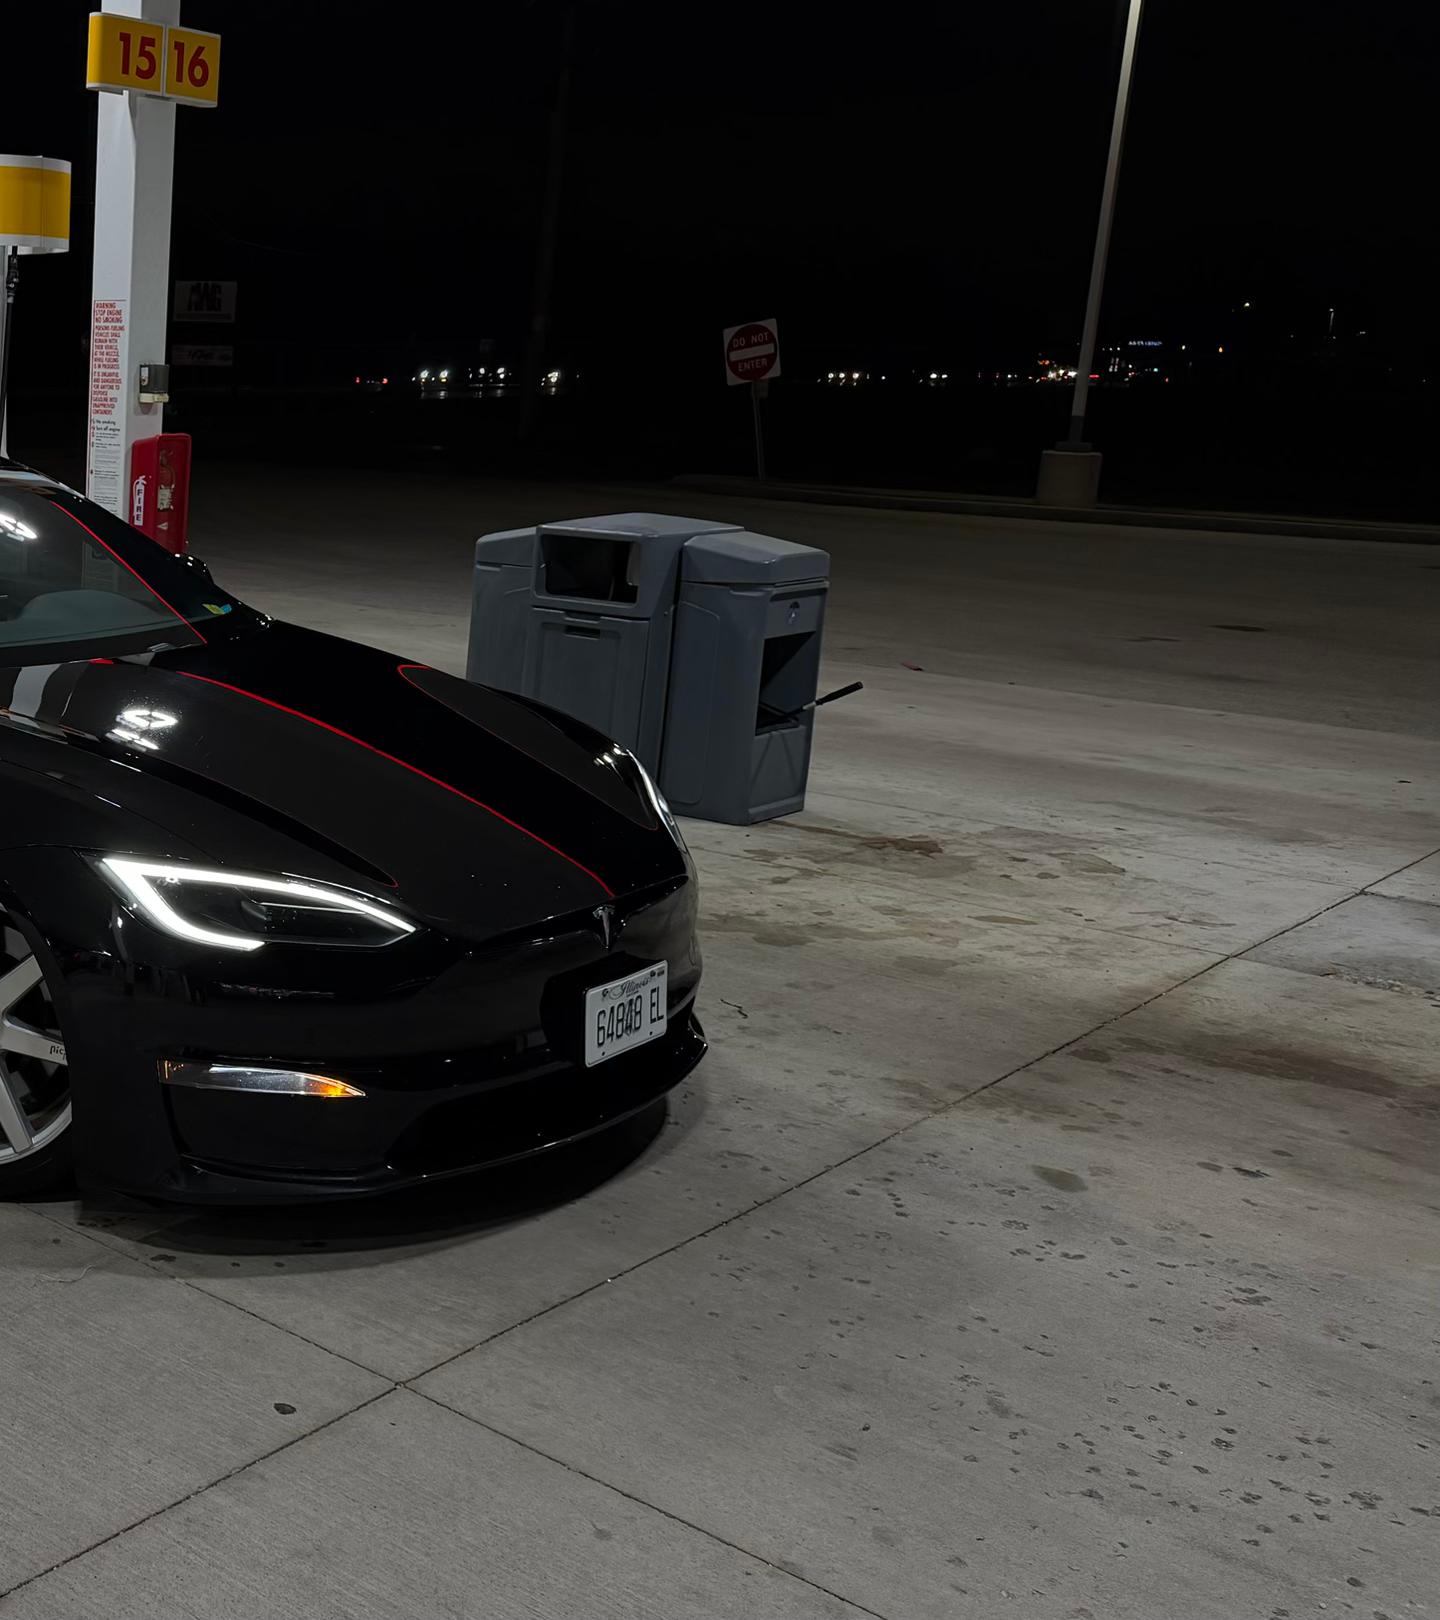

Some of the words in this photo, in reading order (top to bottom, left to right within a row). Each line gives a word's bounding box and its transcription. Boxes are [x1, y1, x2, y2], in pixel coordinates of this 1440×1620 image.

[119, 32, 156, 80] 15
[173, 40, 209, 88] 16
[732, 337, 746, 348] DO
[751, 331, 769, 344] NOT
[738, 359, 768, 371] ENTER
[597, 995, 642, 1047] 64848
[650, 986, 665, 1024] EL
